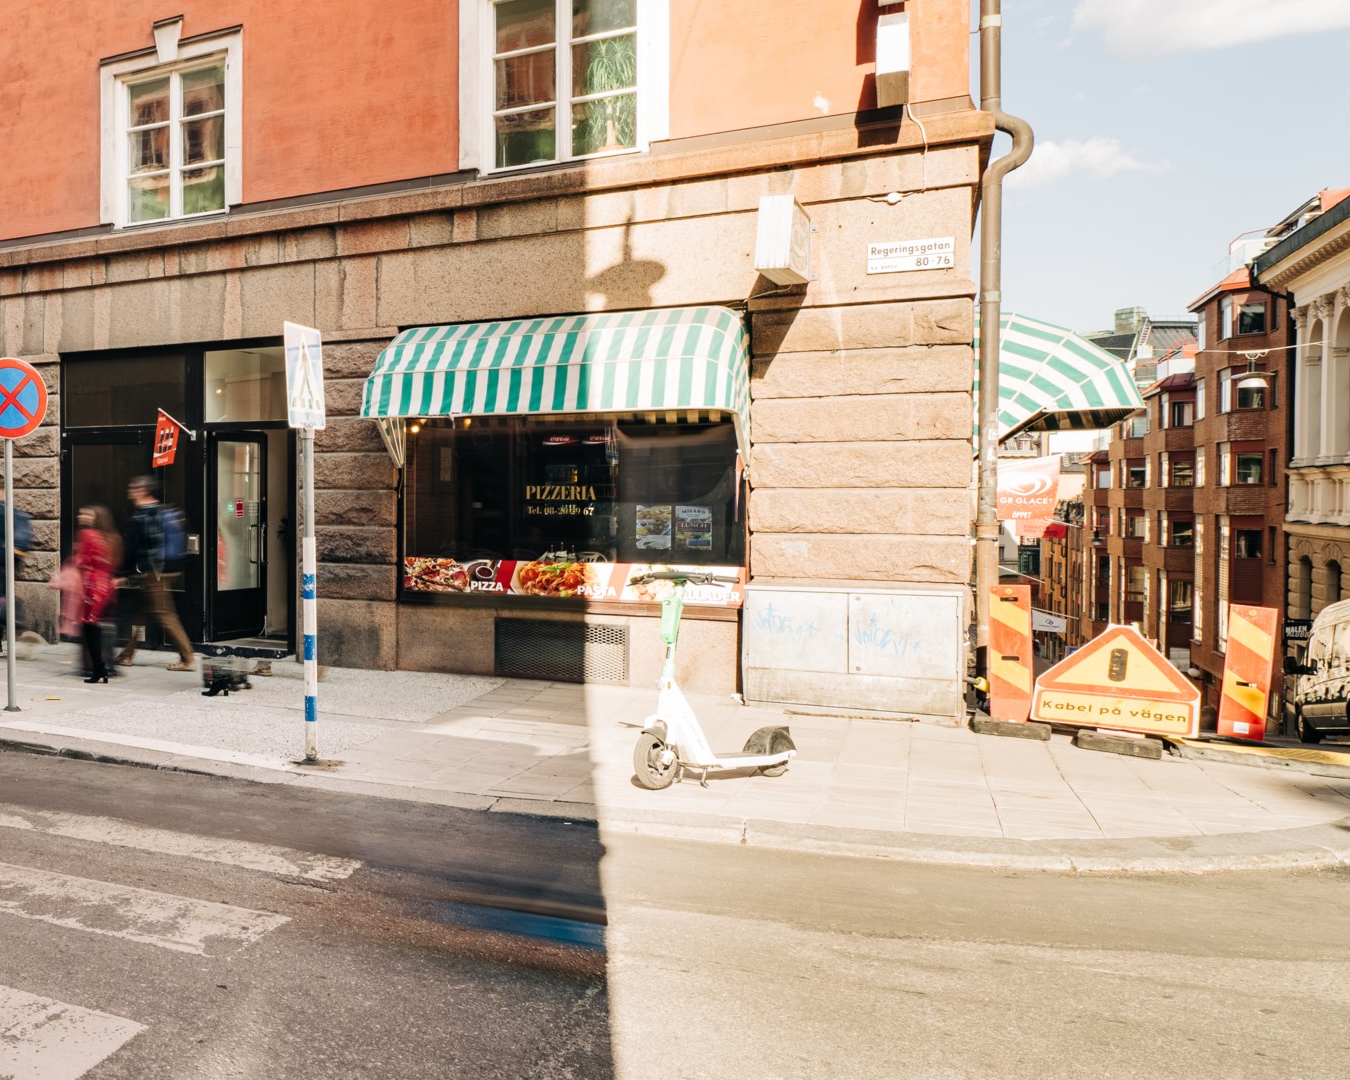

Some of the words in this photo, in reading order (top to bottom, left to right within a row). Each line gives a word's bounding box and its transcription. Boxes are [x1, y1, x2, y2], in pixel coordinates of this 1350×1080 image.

[871, 242, 950, 257] Regeringsgatan
[916, 256, 950, 267] 80-76
[525, 486, 596, 500] PIZZERIA
[528, 506, 542, 514] Tel.
[470, 580, 503, 592] PIZZA
[577, 585, 617, 597] PASTA
[1042, 700, 1092, 712] Kabel
[1100, 706, 1121, 716] på
[1130, 710, 1186, 722] vägen
